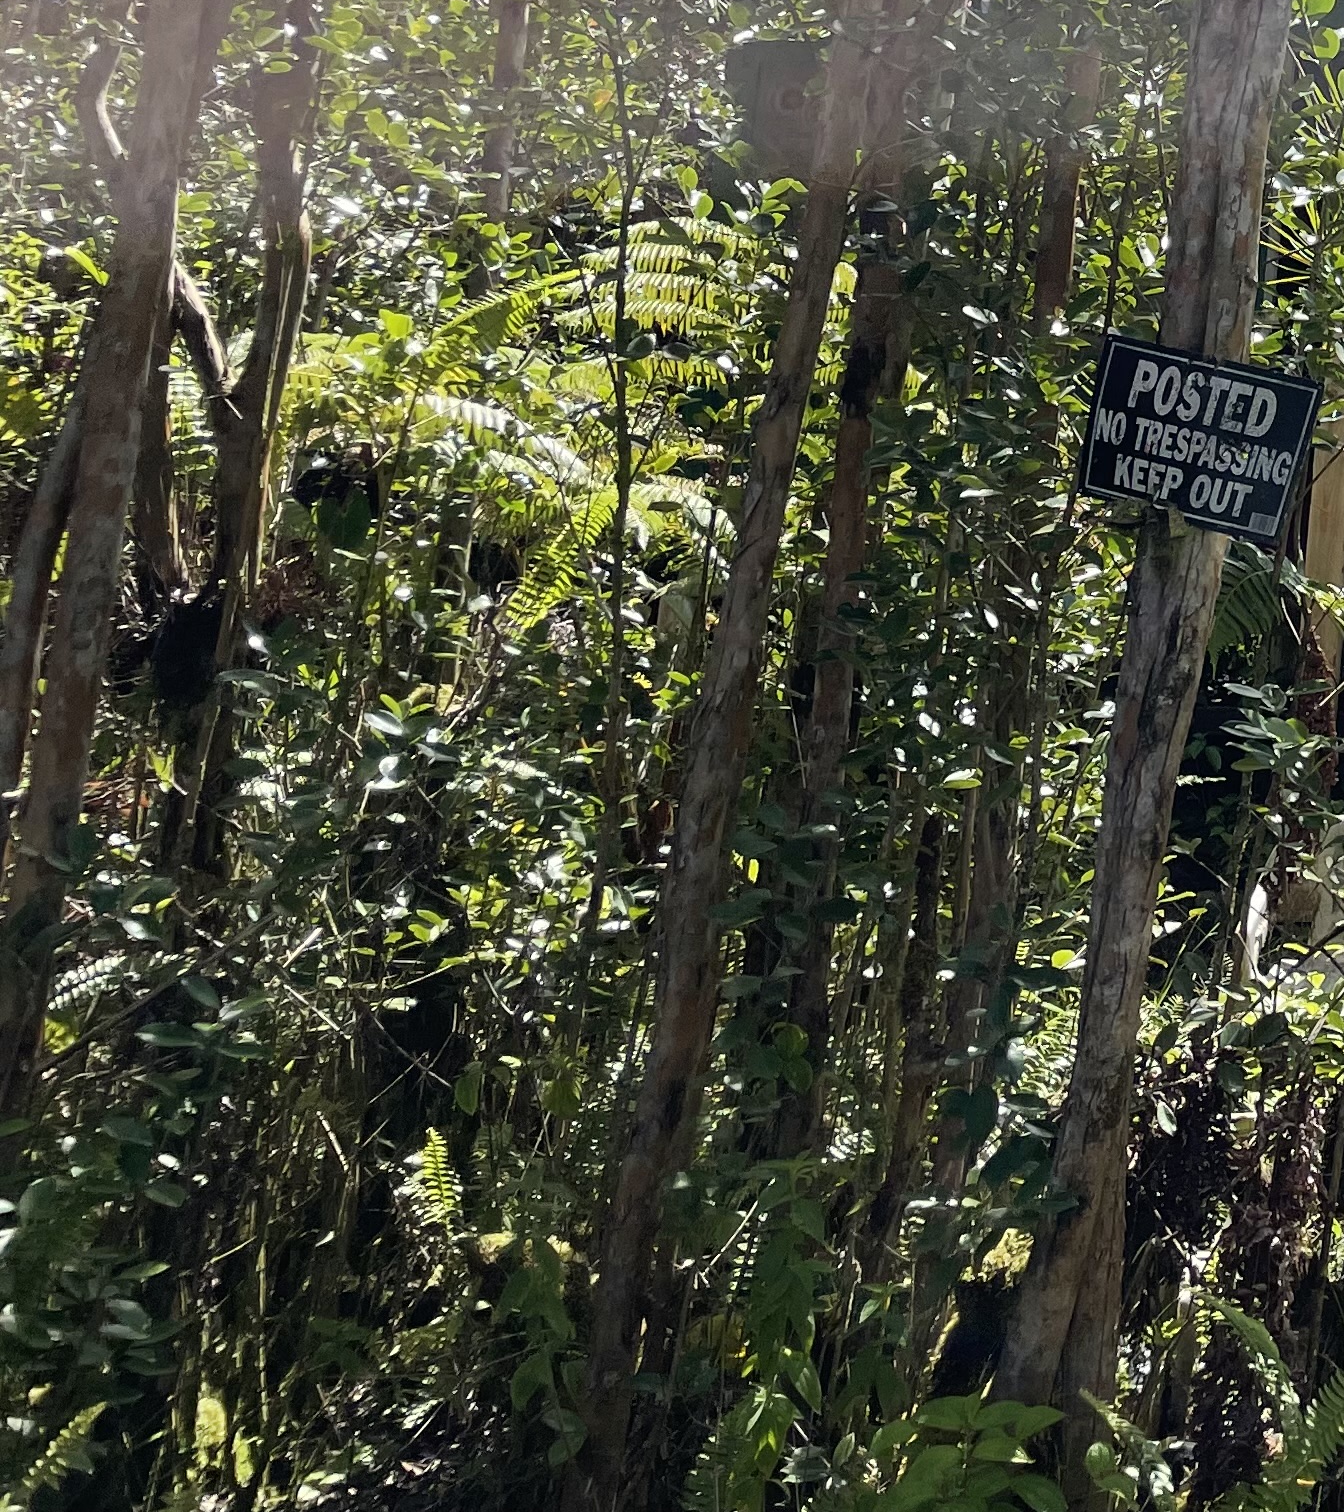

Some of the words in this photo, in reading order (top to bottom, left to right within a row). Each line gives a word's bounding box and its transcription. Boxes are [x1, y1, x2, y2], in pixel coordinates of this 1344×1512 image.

[1127, 359, 1278, 437] POSTED
[1095, 408, 1127, 445] NO
[1134, 417, 1292, 486] TRESPASSING
[1113, 453, 1184, 501] KEEP
[1189, 474, 1254, 518] OUT
